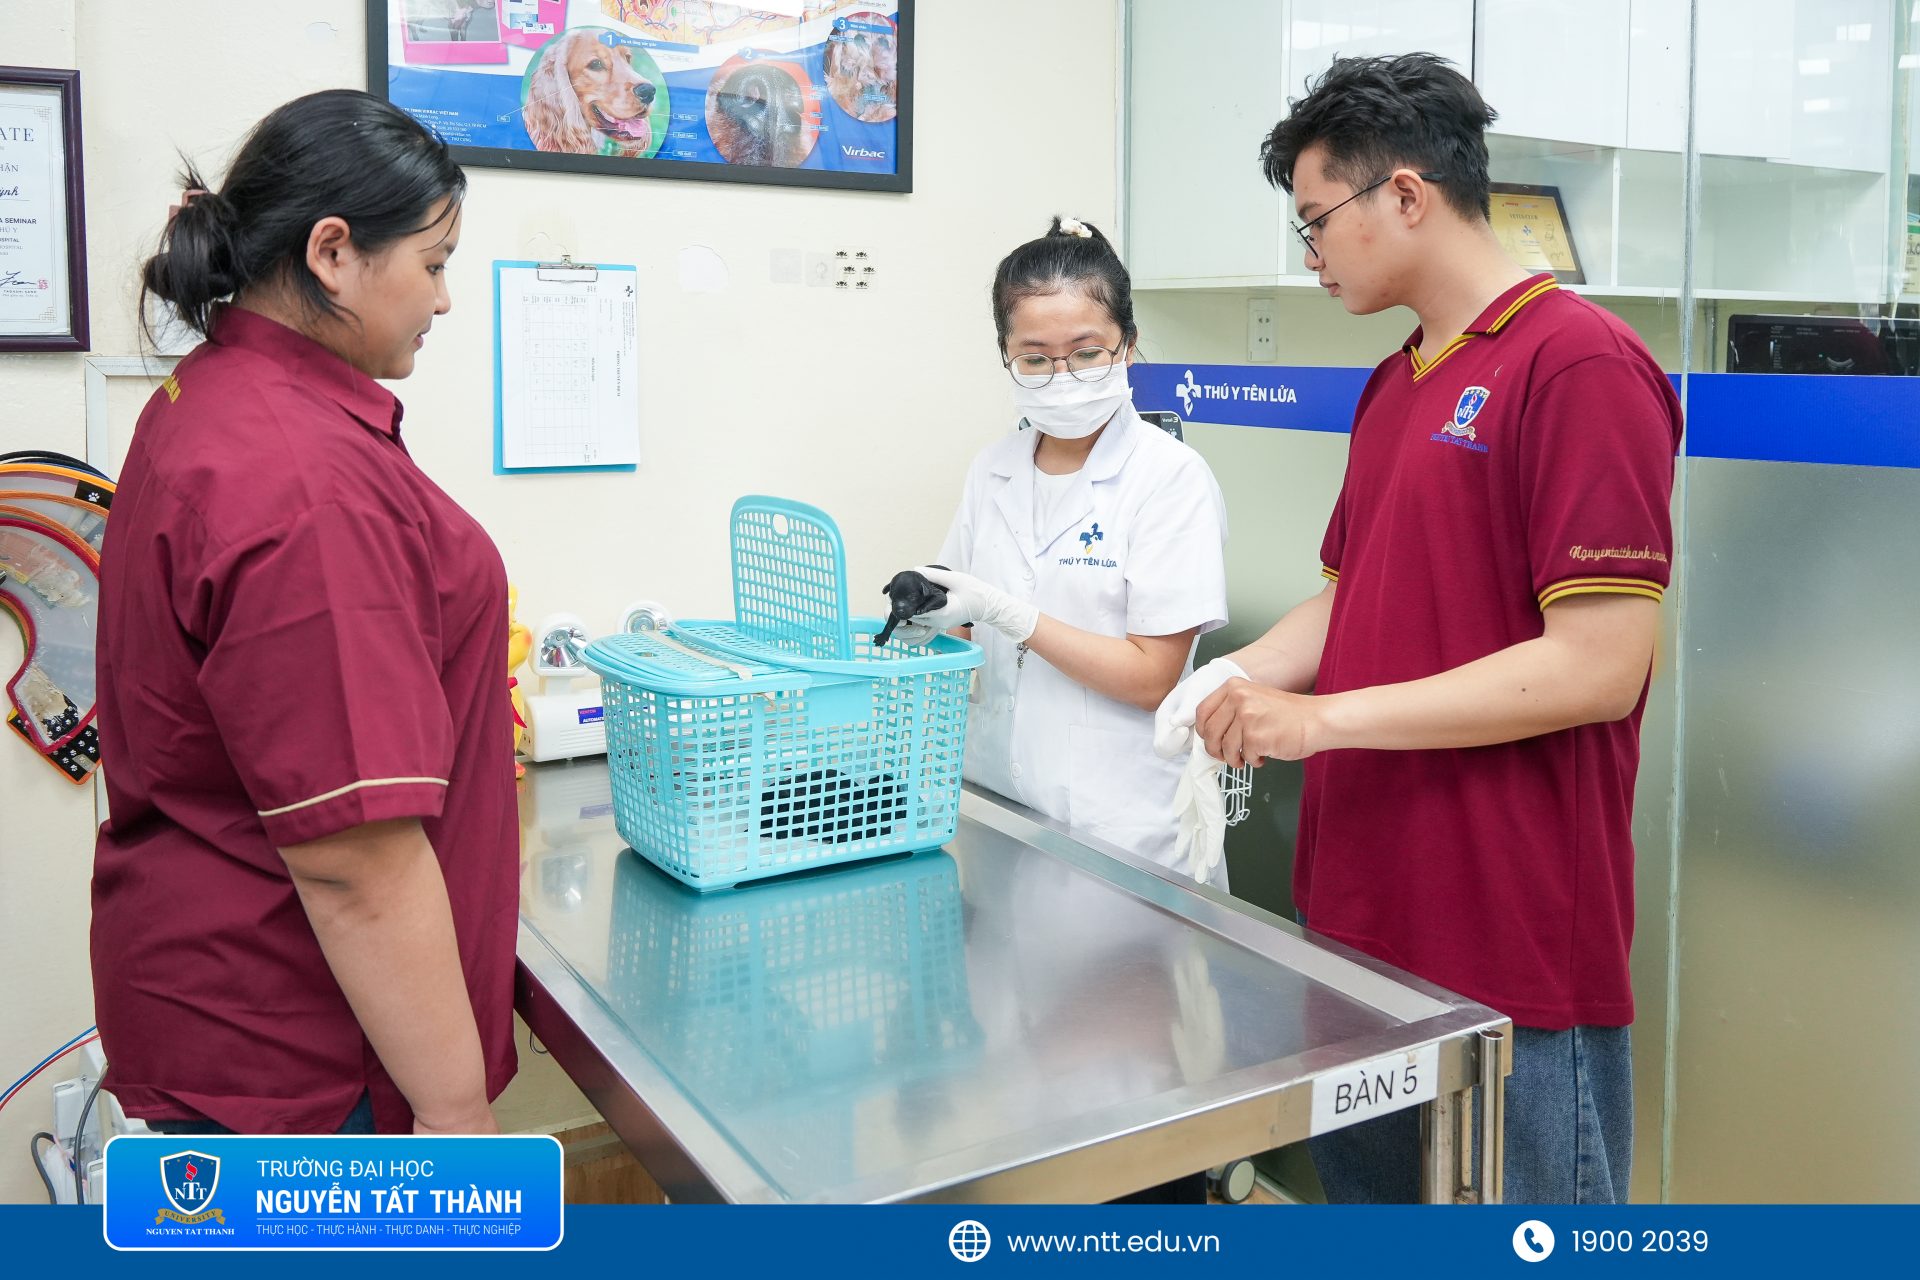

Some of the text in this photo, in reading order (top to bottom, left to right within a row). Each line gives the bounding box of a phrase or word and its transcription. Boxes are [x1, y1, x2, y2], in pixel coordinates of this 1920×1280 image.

[839, 19, 846, 30] 3
[607, 34, 613, 45] 1
[744, 48, 752, 59] 2
[842, 145, 886, 158] Virbac
[5, 217, 37, 225] SEMINAR
[1204, 383, 1297, 403] THÚ Y TÊN LỬA
[1458, 405, 1475, 420] NTT
[1083, 557, 1100, 566] TÊN
[1335, 1065, 1418, 1114] BÀN 5
